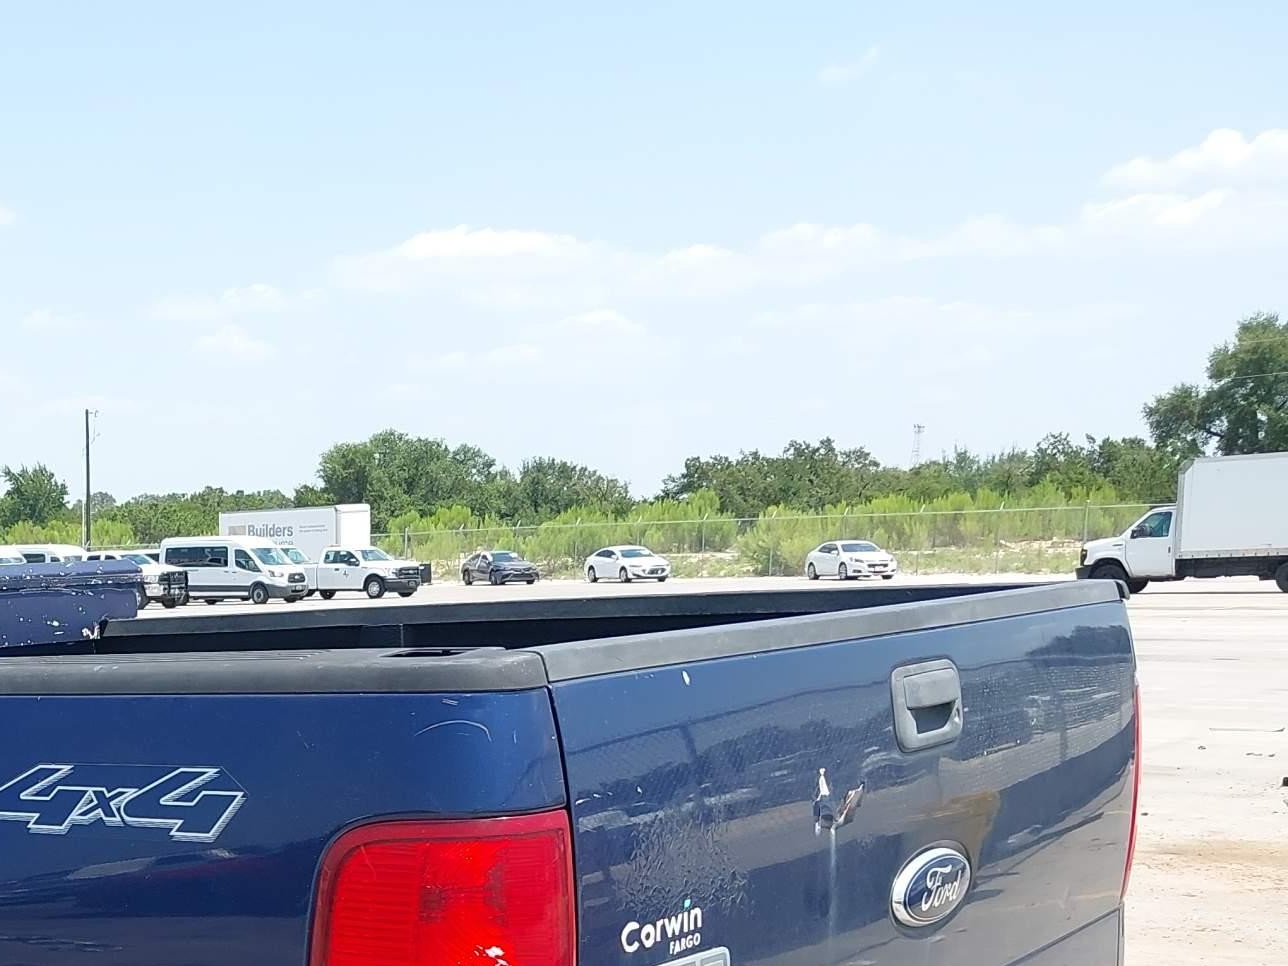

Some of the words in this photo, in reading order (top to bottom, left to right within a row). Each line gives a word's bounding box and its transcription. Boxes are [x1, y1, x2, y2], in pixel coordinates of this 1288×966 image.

[247, 523, 294, 538] Builders
[920, 864, 962, 912] Ford
[620, 898, 703, 953] Corwin
[669, 932, 701, 955] FARGO
